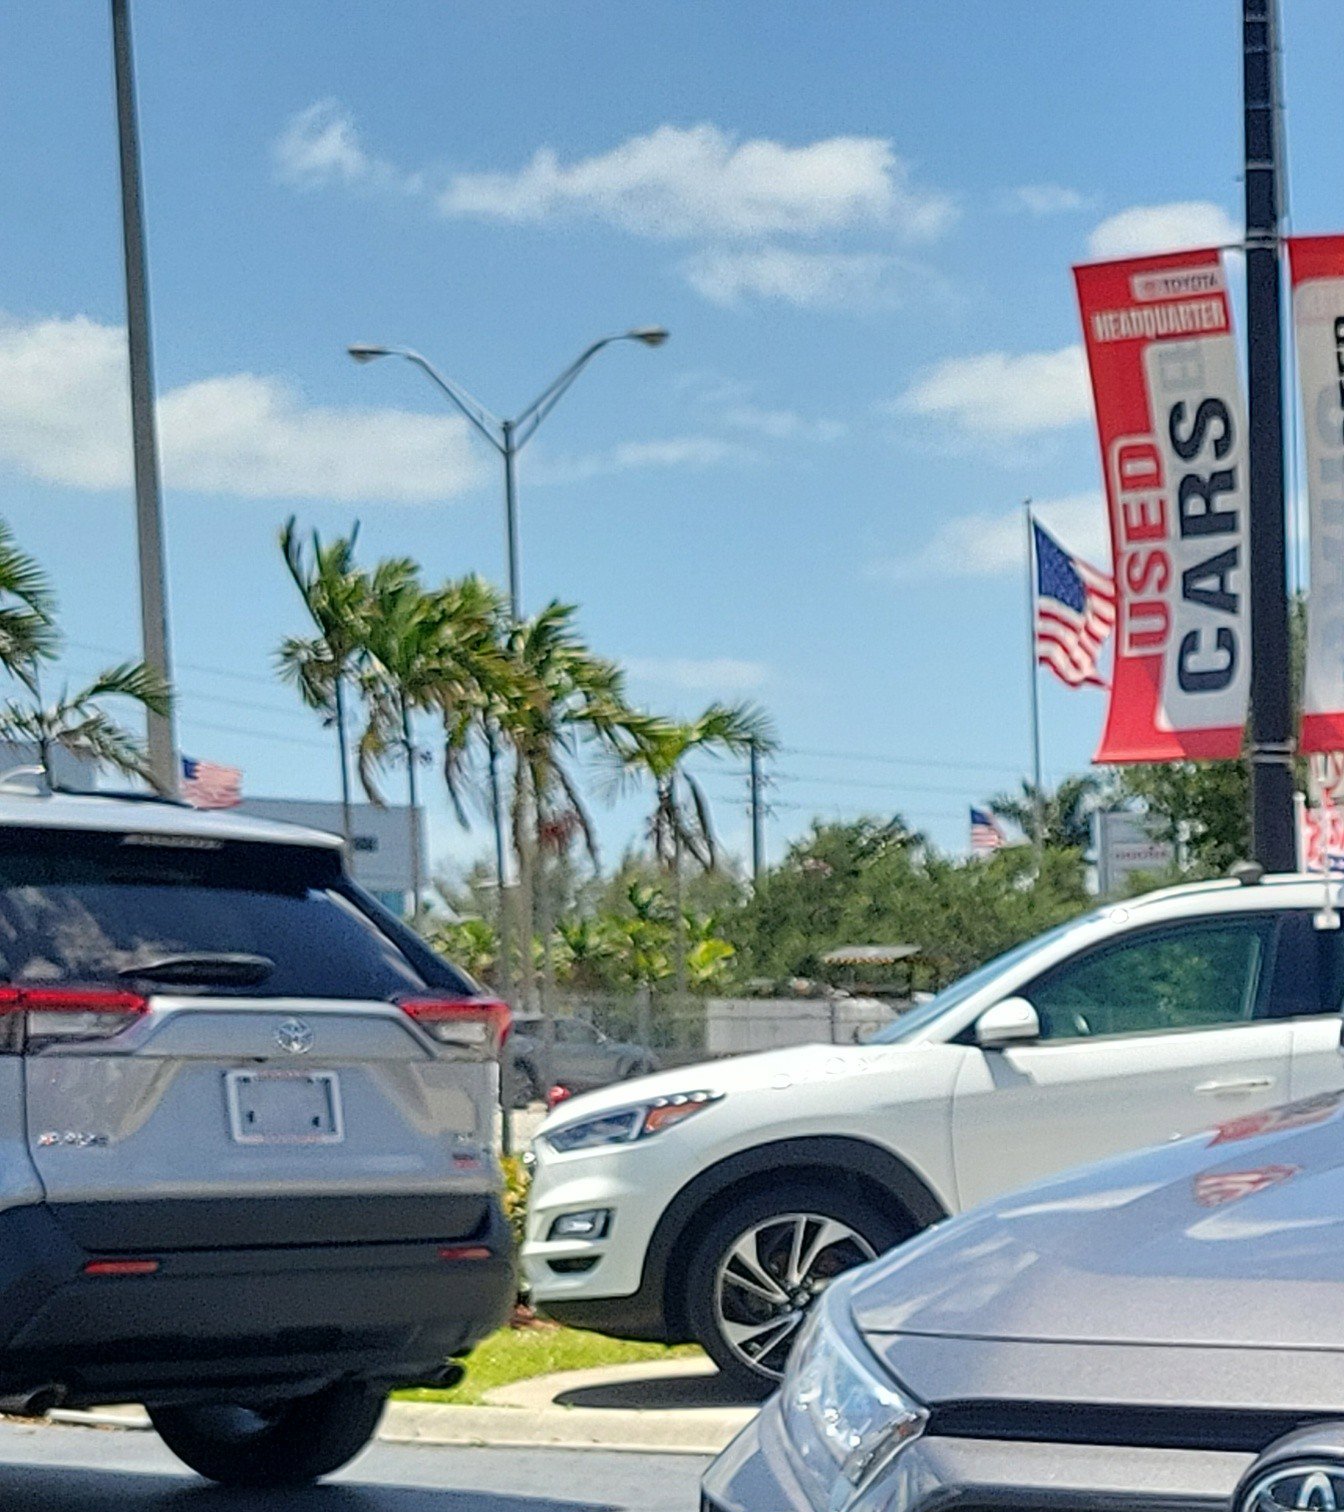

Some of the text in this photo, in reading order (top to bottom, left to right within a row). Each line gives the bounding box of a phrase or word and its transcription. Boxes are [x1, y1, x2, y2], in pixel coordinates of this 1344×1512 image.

[1163, 272, 1218, 291] TOYOTA
[1117, 447, 1169, 652] USED
[1168, 396, 1238, 694] CARS
